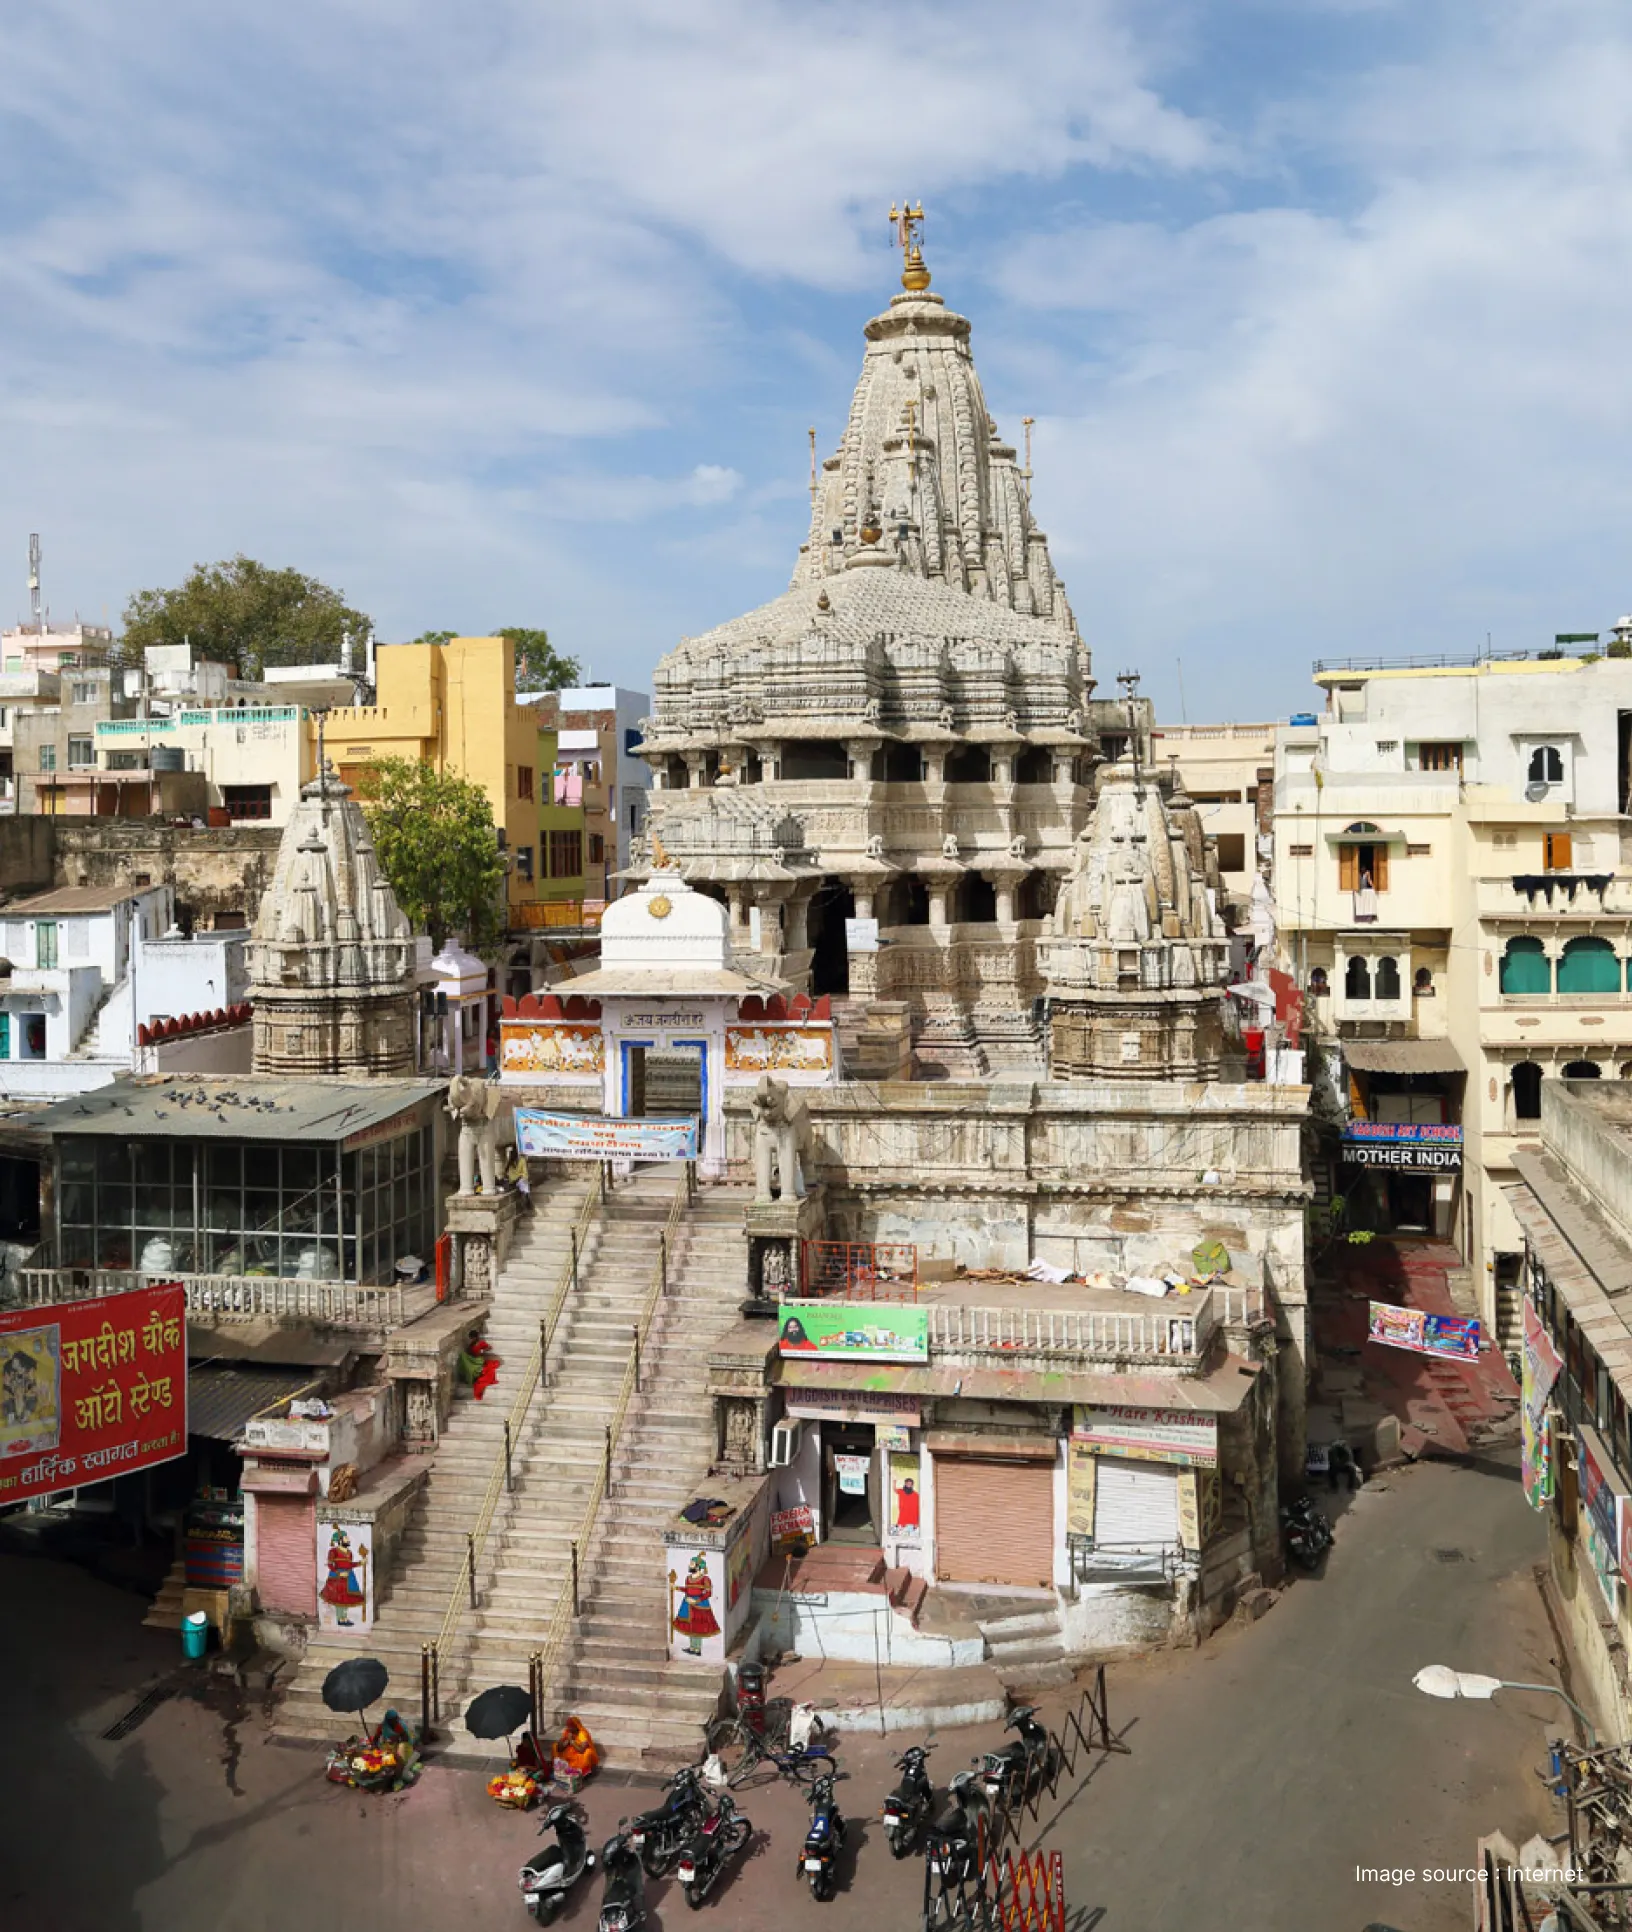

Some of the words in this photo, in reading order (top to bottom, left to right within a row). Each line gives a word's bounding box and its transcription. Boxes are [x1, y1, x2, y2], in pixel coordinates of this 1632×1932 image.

[634, 1014, 652, 1026] जय
[1352, 1123, 1394, 1137] JAGDISH
[1398, 1125, 1417, 1137] ART
[1421, 1125, 1460, 1138] SCHOOL
[1343, 1149, 1412, 1164] MOTHER
[1416, 1151, 1462, 1166] INDIA
[61, 1321, 136, 1374] जगदीश
[142, 1310, 181, 1355] चौक
[75, 1378, 123, 1431] ऑटो
[789, 1388, 838, 1404] JAGDISH
[841, 1389, 917, 1414] ENTERPRISES
[1109, 1405, 1148, 1421] Hare
[1153, 1408, 1216, 1428] Krishna
[20, 1453, 76, 1485] हार्दिक
[82, 1439, 140, 1469] स्वागत
[771, 1505, 810, 1524] FOREIGN
